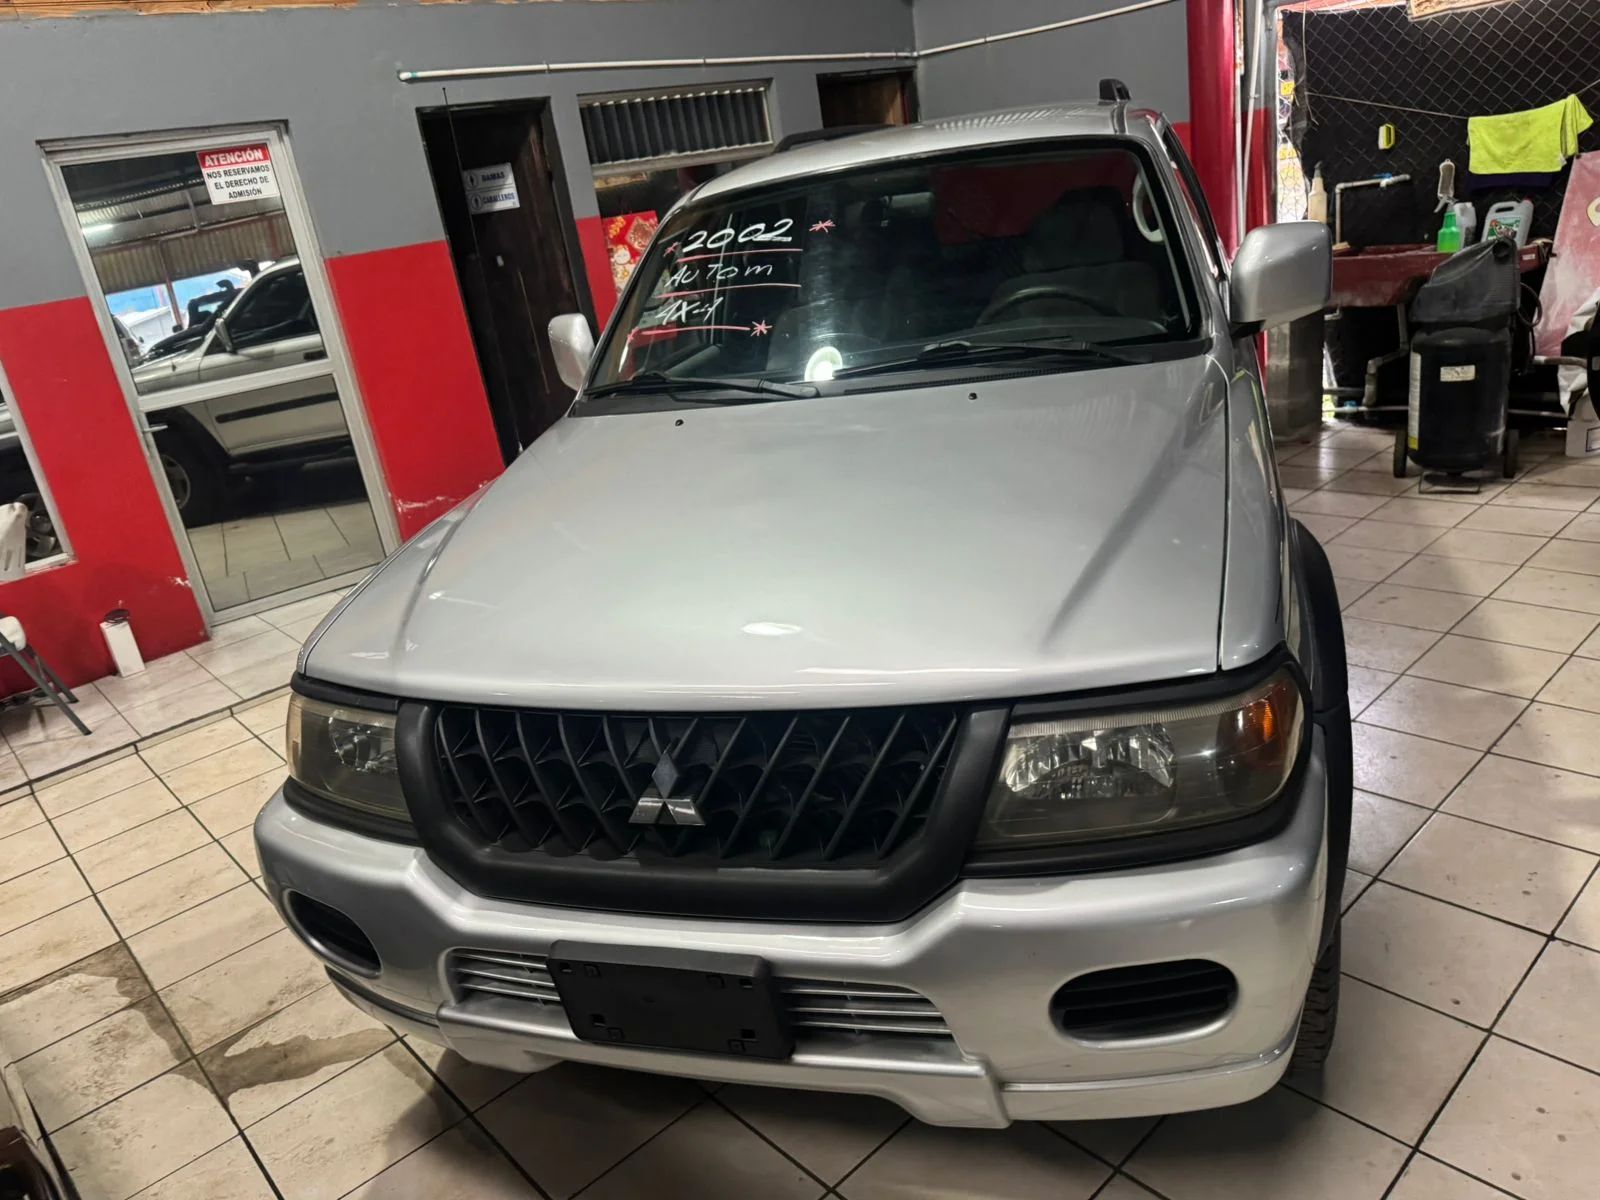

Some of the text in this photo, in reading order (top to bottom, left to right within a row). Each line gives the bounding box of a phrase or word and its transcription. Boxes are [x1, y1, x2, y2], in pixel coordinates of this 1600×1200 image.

[204, 147, 264, 167] ATENCIÓN
[206, 164, 270, 179] NOS RESERVAMOS
[214, 175, 270, 190] EL DERECHO DE
[228, 187, 262, 199] ADMISIÓN
[682, 218, 793, 253] 2002
